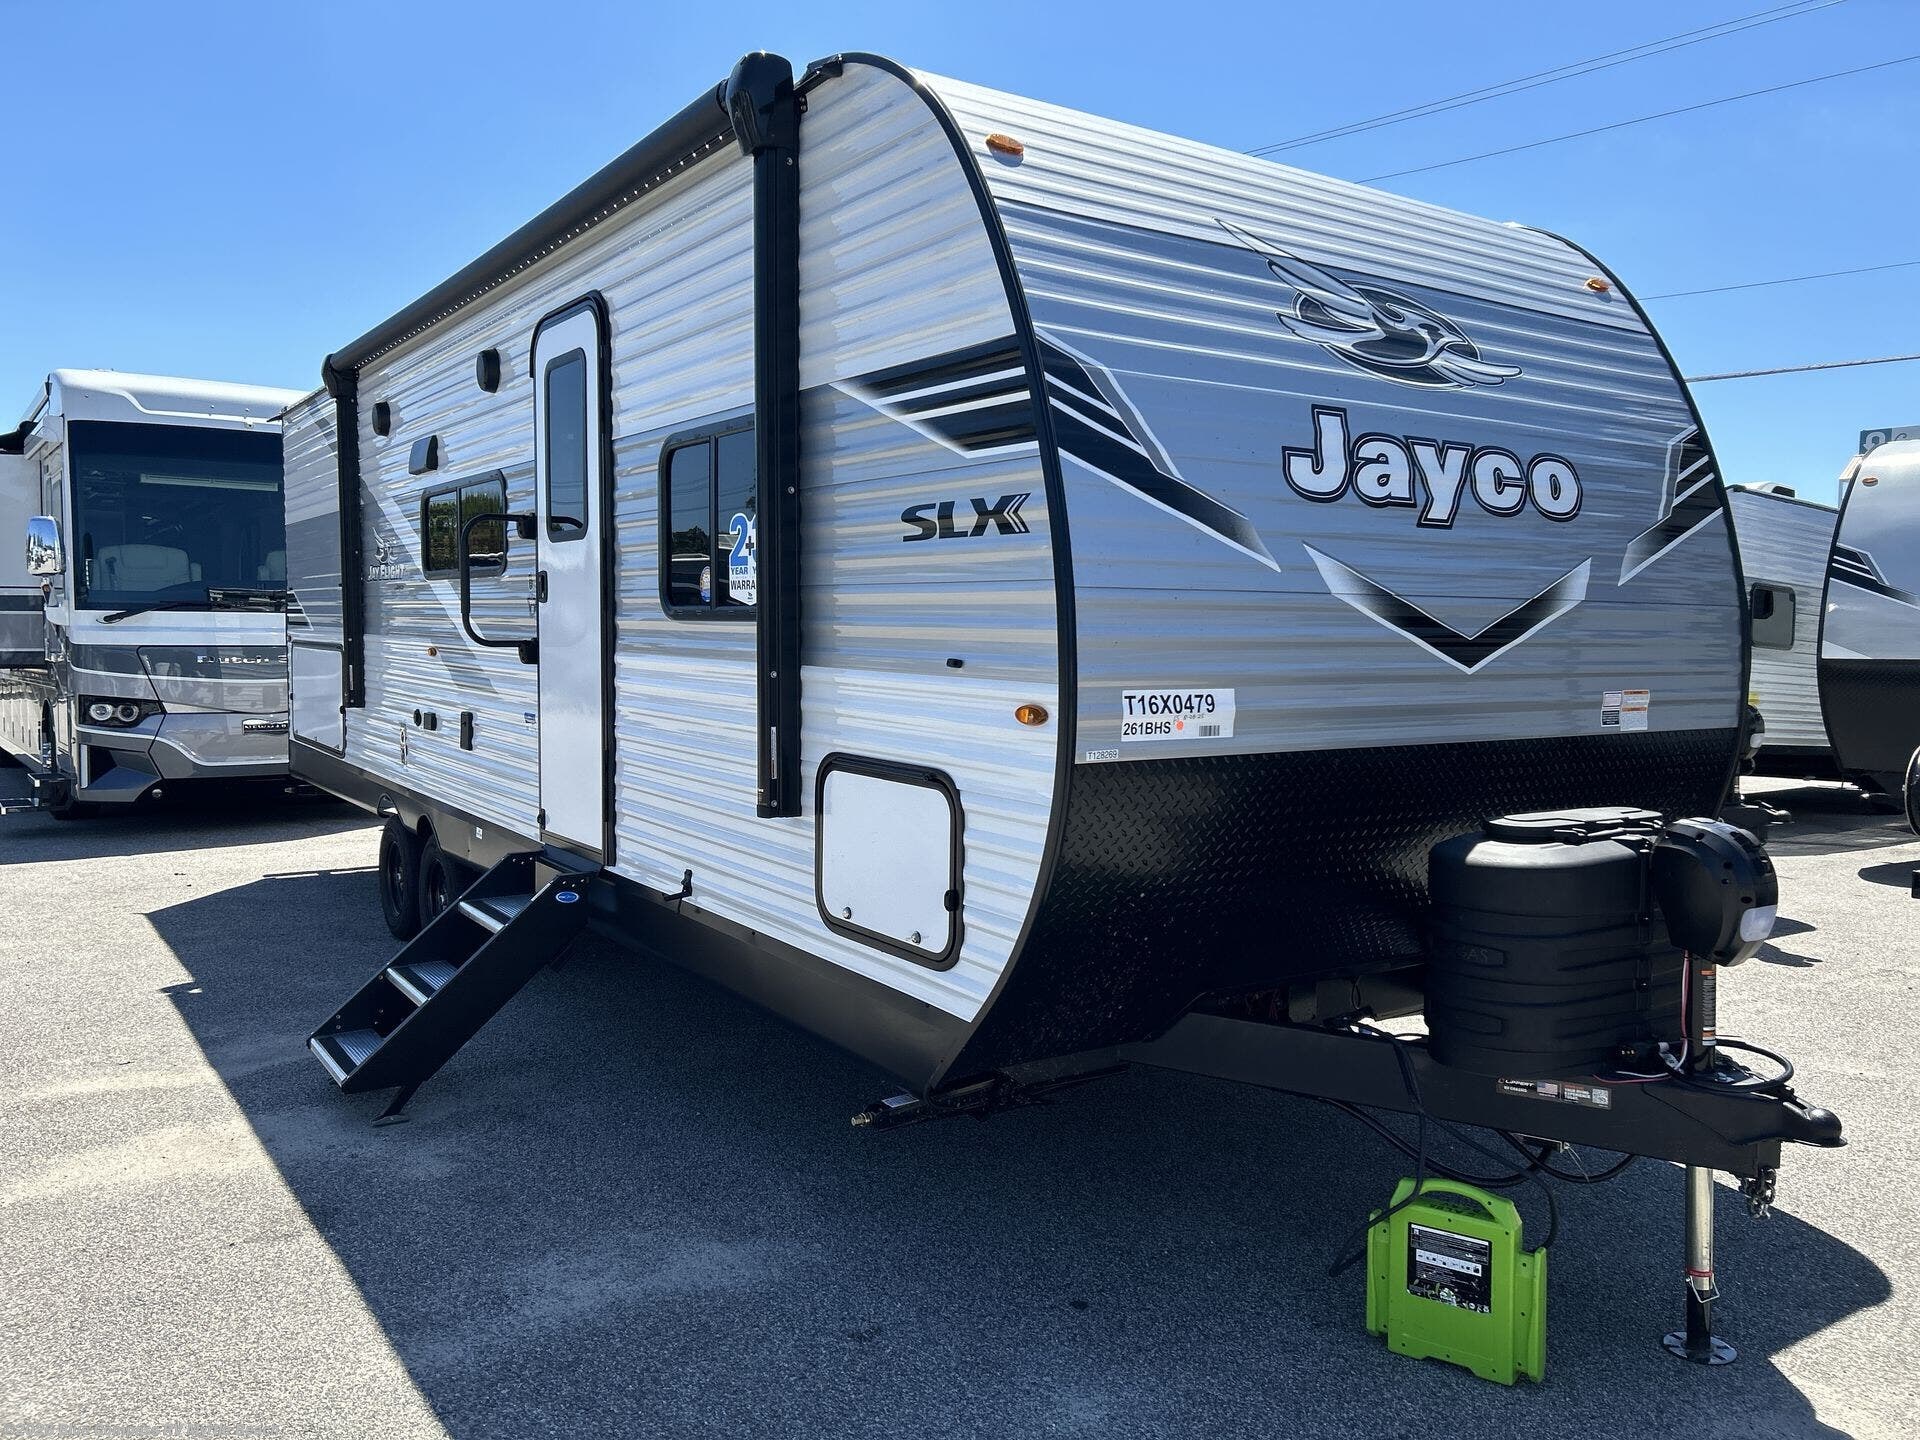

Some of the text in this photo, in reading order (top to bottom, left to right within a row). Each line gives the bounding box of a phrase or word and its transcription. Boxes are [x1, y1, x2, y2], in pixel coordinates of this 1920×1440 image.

[1282, 403, 1583, 530] Jayco
[901, 493, 1031, 542] SLX
[367, 564, 404, 581] JAY FLIGHT
[731, 566, 748, 576] YEAR
[731, 579, 757, 591] WARRA
[197, 655, 270, 664] Dutch
[1124, 694, 1216, 716] T16X0479
[1123, 721, 1171, 736] 261BHS
[1087, 751, 1118, 760] T128269
